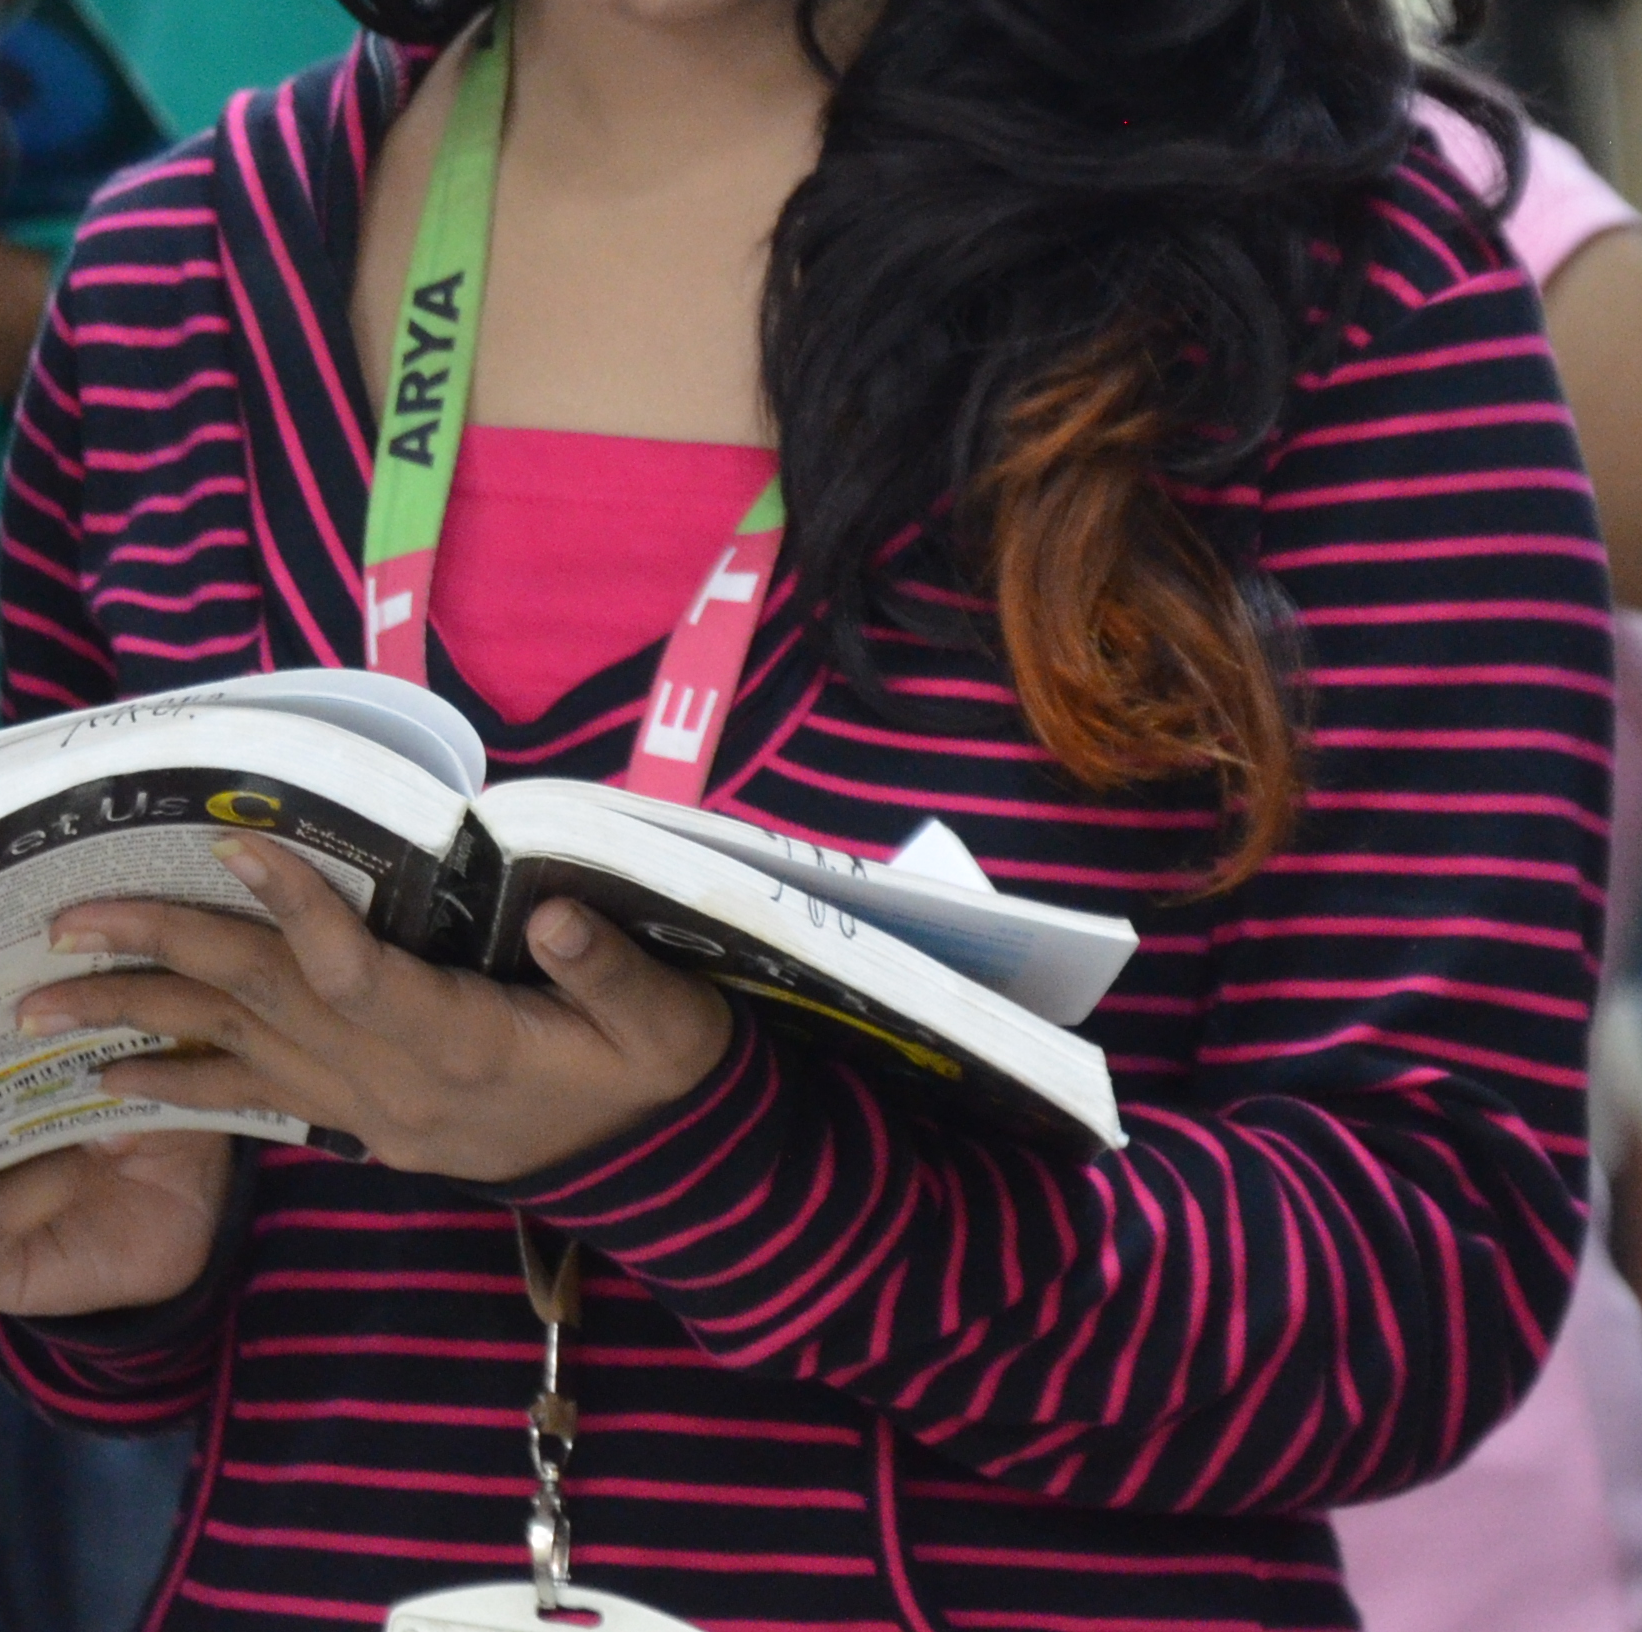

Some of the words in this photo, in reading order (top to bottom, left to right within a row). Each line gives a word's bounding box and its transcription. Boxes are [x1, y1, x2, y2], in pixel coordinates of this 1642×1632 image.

[388, 270, 466, 469] ARYA
[100, 790, 191, 823] Us
[205, 789, 282, 828] C
